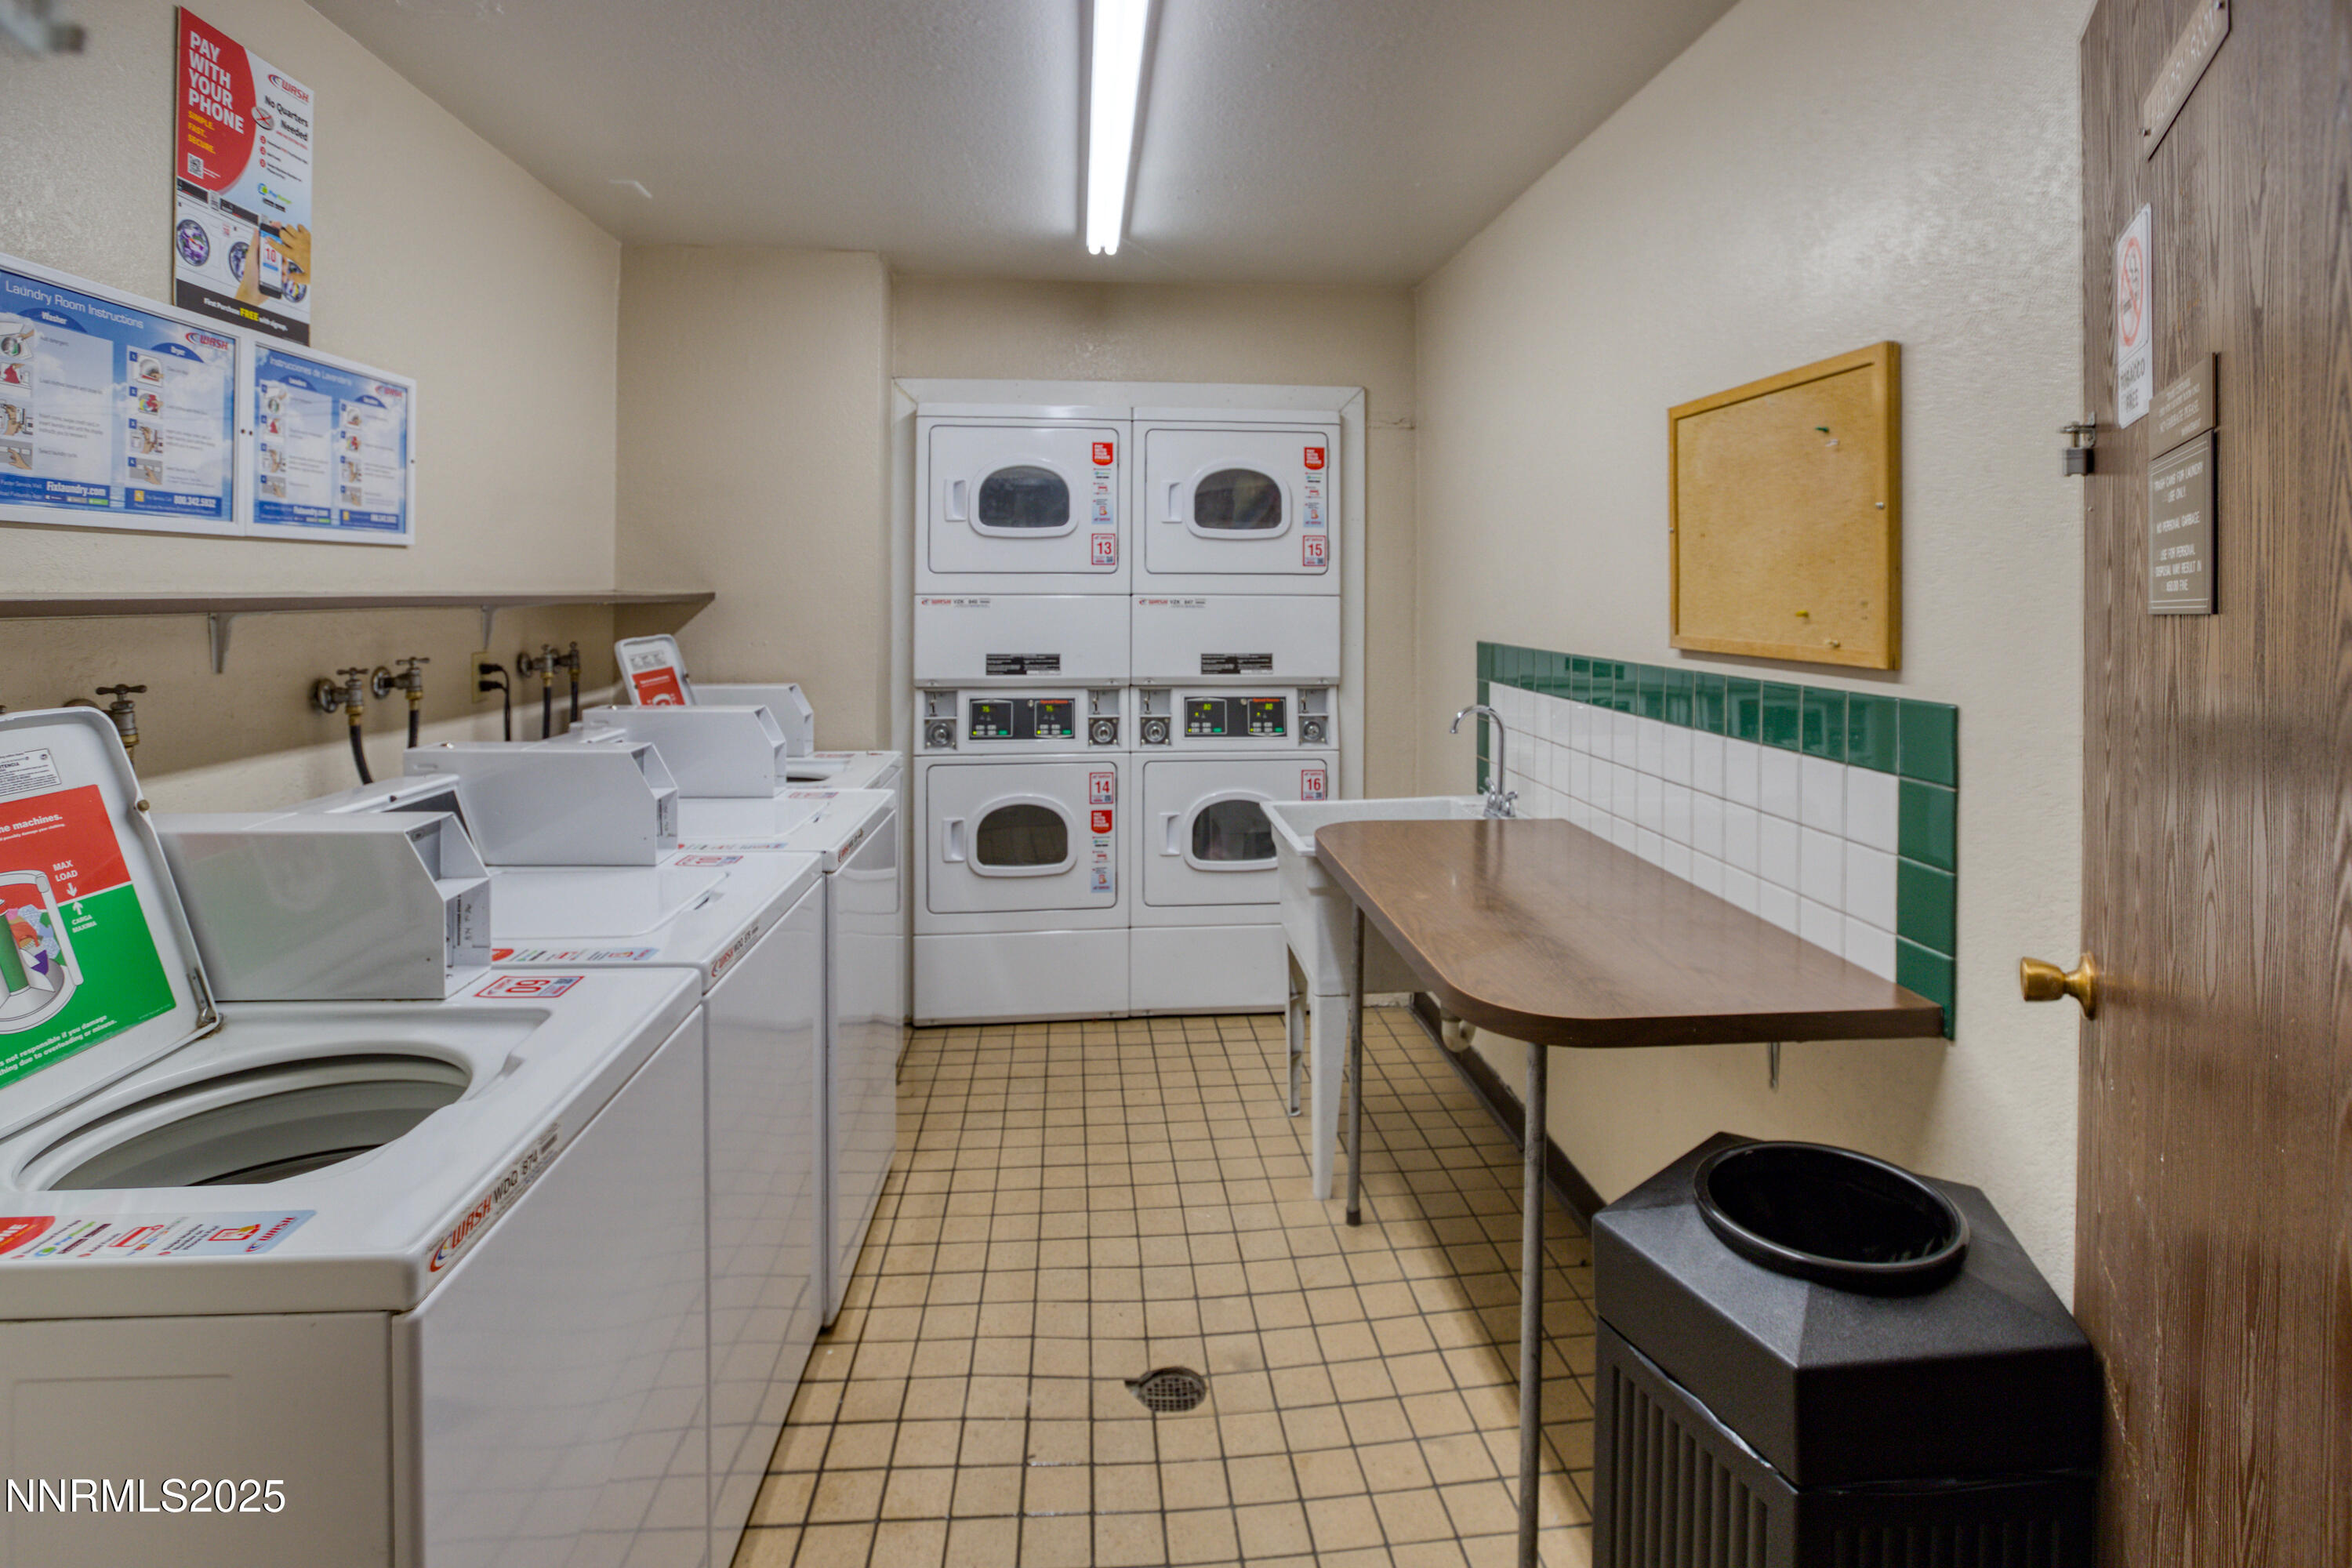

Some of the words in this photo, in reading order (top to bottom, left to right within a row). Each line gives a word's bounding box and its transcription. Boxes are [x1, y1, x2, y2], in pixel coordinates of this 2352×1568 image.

[190, 30, 220, 64] PAY
[189, 49, 230, 90] WITH
[188, 67, 233, 111] YOUR
[281, 79, 309, 103] WASH
[188, 87, 244, 135] PHONE
[265, 95, 275, 109] No
[276, 103, 309, 128] Quarters
[281, 119, 308, 142] Needed
[265, 248, 277, 263] 10
[5, 280, 53, 306] Laundry
[54, 294, 86, 313] Room
[88, 303, 144, 330] Instructions
[204, 297, 216, 307] First
[240, 307, 260, 322] FREE
[42, 310, 67, 326] Washer
[199, 333, 229, 350] WASH
[46, 481, 107, 497] Fixlaundry.com
[1097, 542, 1112, 555] 13
[1308, 543, 1323, 557] 15
[1094, 780, 1109, 793] 14
[1307, 778, 1321, 791] 16
[13, 814, 64, 830] machines.
[53, 860, 74, 871] MAX
[55, 869, 78, 882] LOAD
[71, 914, 93, 926] CARGA
[72, 920, 97, 934] MAXIMA
[5, 1054, 19, 1065] not
[20, 1035, 61, 1058] responsible
[62, 1030, 67, 1040] if
[67, 1026, 81, 1037] you
[82, 1014, 107, 1030] damage
[19, 1056, 33, 1067] due
[34, 1051, 43, 1060] to
[44, 1033, 84, 1056] overloading
[93, 1019, 118, 1034] misuse.
[452, 1194, 492, 1250] WASH
[493, 1170, 520, 1203] WDQ
[257, 1216, 297, 1241] WASH
